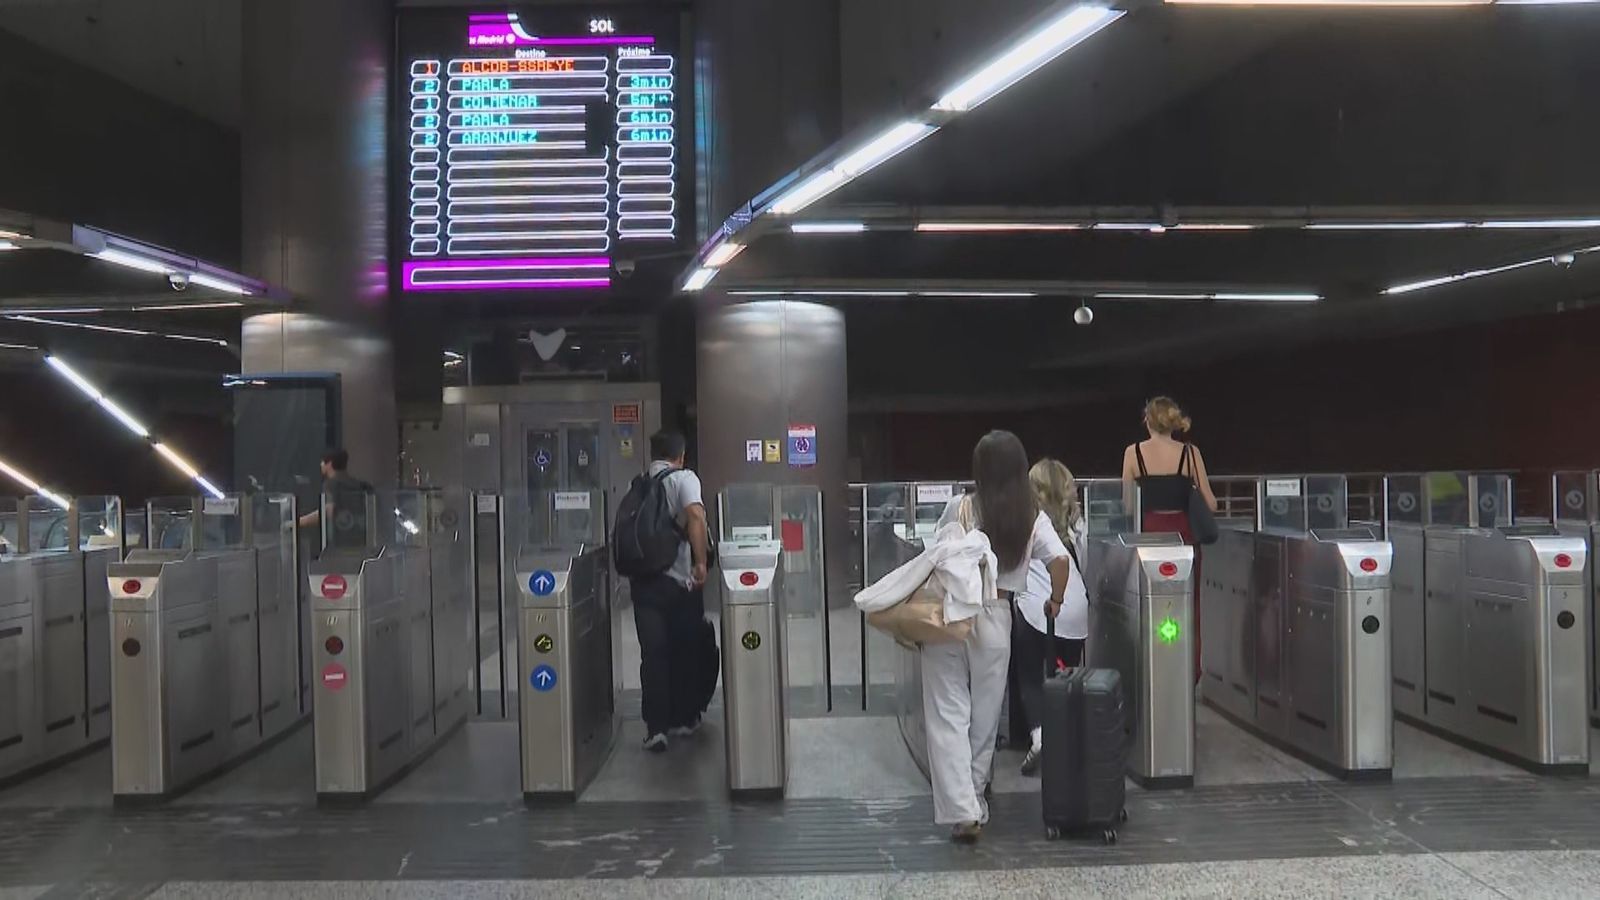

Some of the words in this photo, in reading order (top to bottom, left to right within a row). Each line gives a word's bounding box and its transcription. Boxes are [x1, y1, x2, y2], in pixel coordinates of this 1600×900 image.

[590, 19, 615, 33] SOL
[477, 34, 505, 45] Madrid
[515, 47, 547, 58] Destino
[426, 61, 433, 74] 1
[425, 80, 435, 92] 2
[462, 79, 509, 91] PARLA
[631, 75, 669, 88] 3min
[426, 97, 433, 110] 1
[462, 95, 537, 109] COLMENAR
[425, 115, 435, 127] 2
[462, 113, 509, 127] PARLA
[631, 111, 669, 124] 6min
[425, 133, 435, 145] 2
[462, 130, 537, 144] ARANJUEZ
[631, 129, 669, 141] 6min
